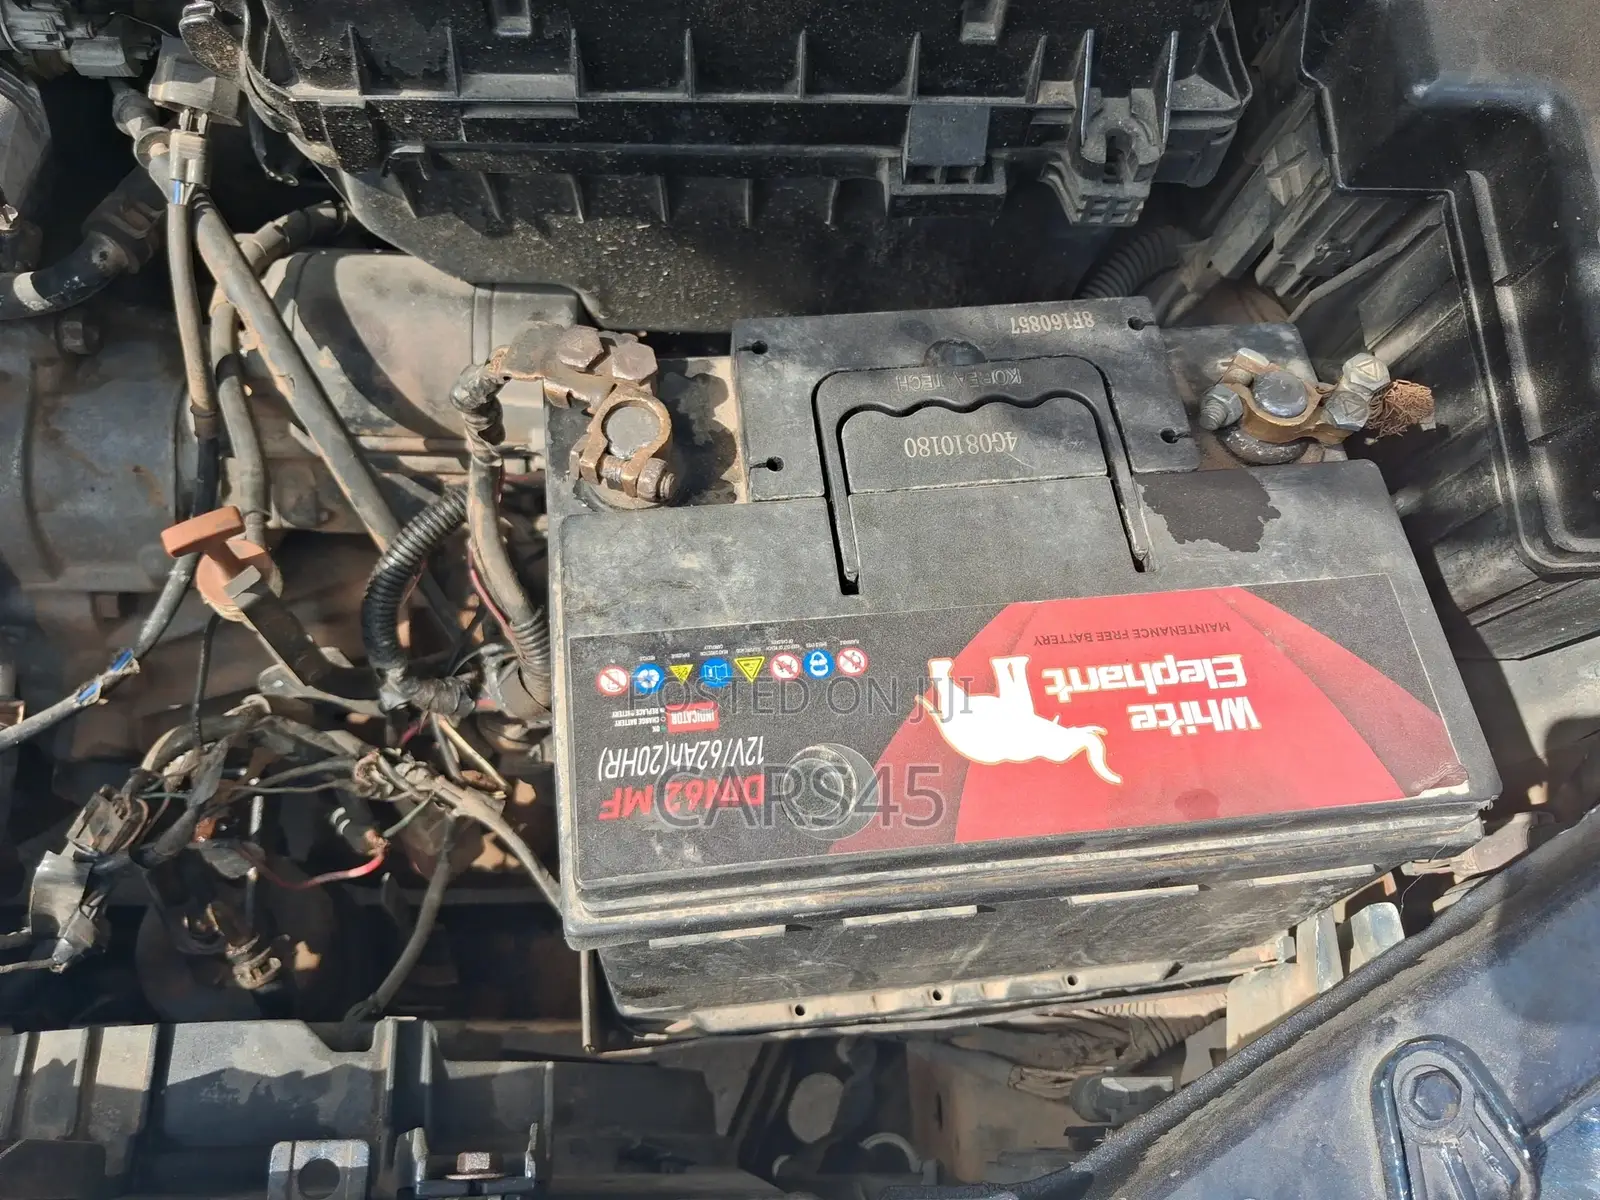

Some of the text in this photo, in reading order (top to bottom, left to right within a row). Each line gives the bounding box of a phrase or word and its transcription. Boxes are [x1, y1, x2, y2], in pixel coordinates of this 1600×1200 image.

[1010, 311, 1095, 335] 8F160857
[895, 374, 945, 392] TECH
[904, 431, 1018, 458] 4G0810180
[1033, 621, 1231, 646] MAINTENANCE FREE BATTERY
[1041, 654, 1248, 703] Elephant
[614, 718, 638, 727] BATTERY
[636, 708, 659, 717] REPLACE
[670, 709, 715, 725] INDICATOR
[1127, 696, 1262, 736] White
[598, 736, 764, 781] 12V/62Ah(20HR)
[597, 784, 654, 821] MF
